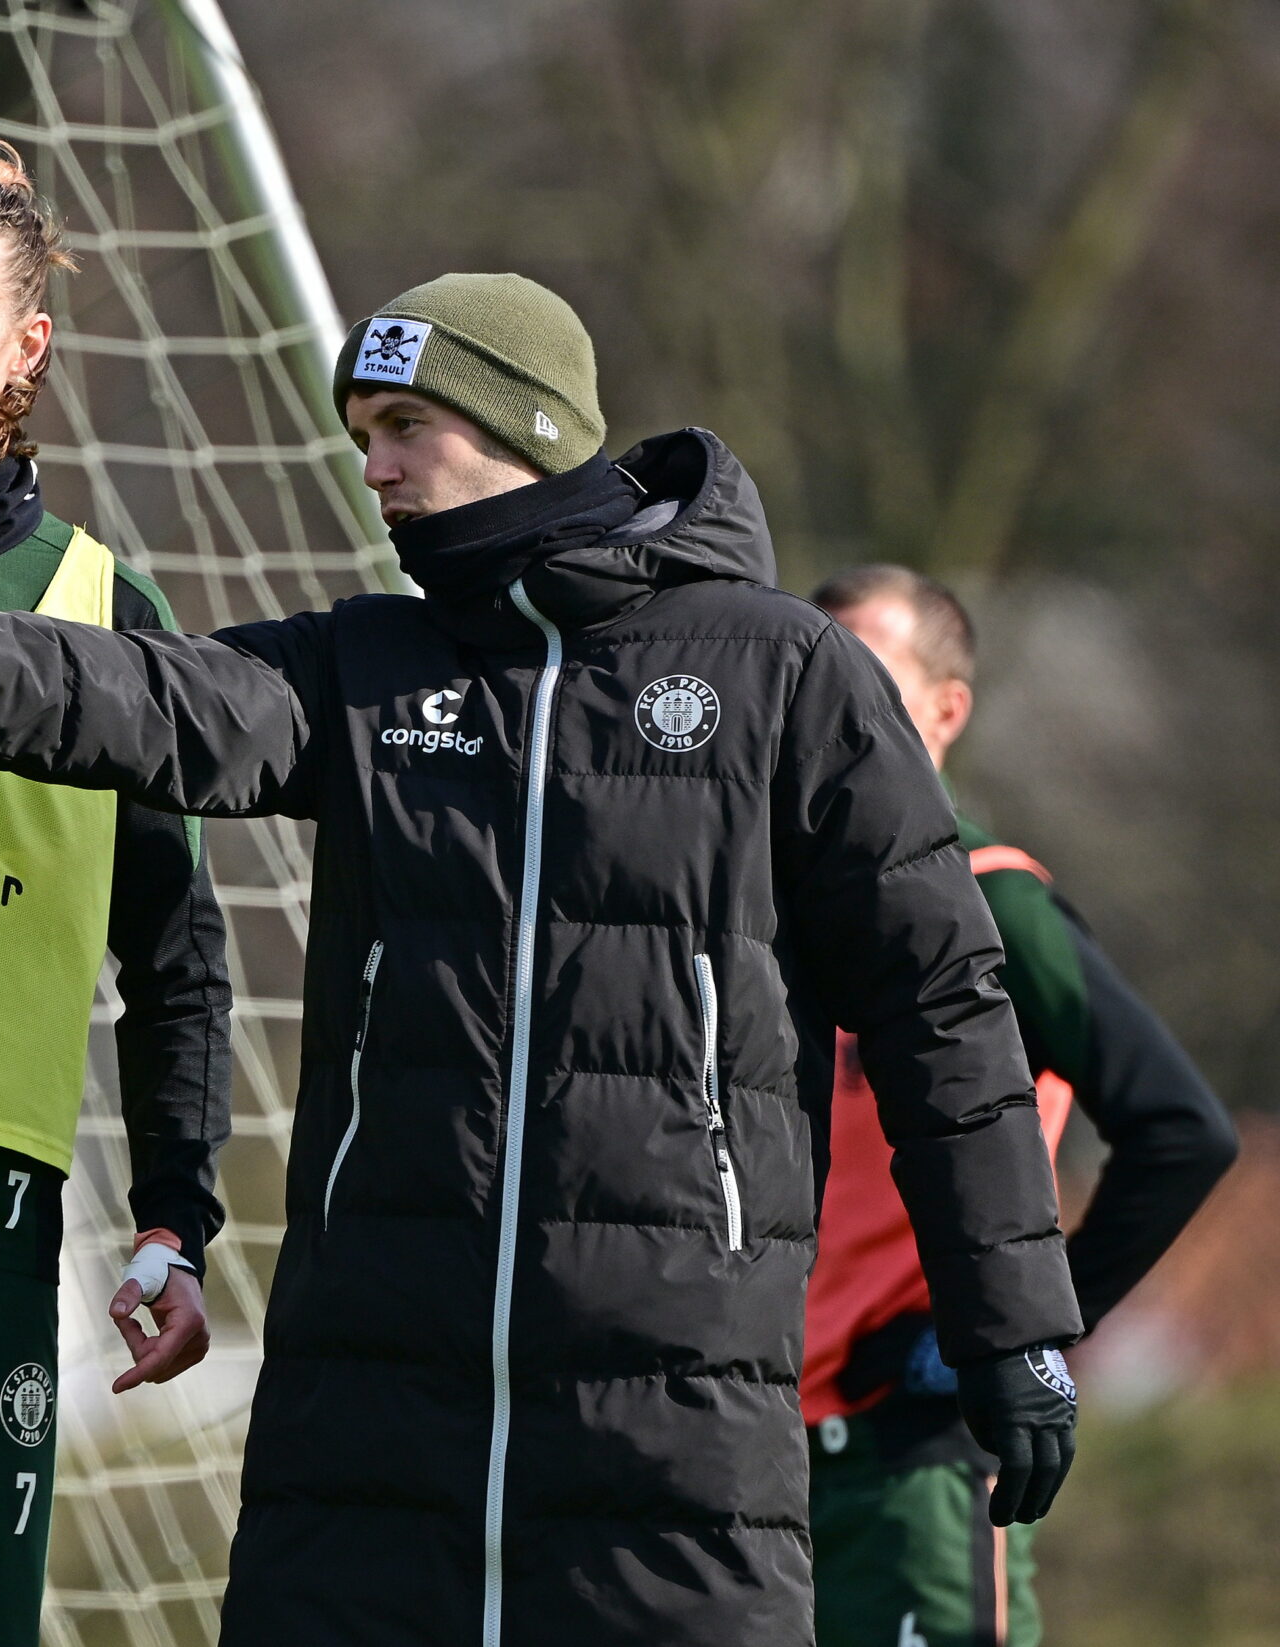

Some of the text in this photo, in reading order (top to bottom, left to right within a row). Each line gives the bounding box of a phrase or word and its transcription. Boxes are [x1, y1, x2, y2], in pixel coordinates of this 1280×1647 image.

[639, 678, 716, 711] FC ST. PAULI
[381, 728, 484, 756] congstar
[659, 734, 693, 748] 1910
[4, 1169, 31, 1230] 7
[3, 1366, 54, 1403] FC ST. PAULI
[19, 1429, 41, 1443] 1910
[13, 1471, 38, 1535] 7
